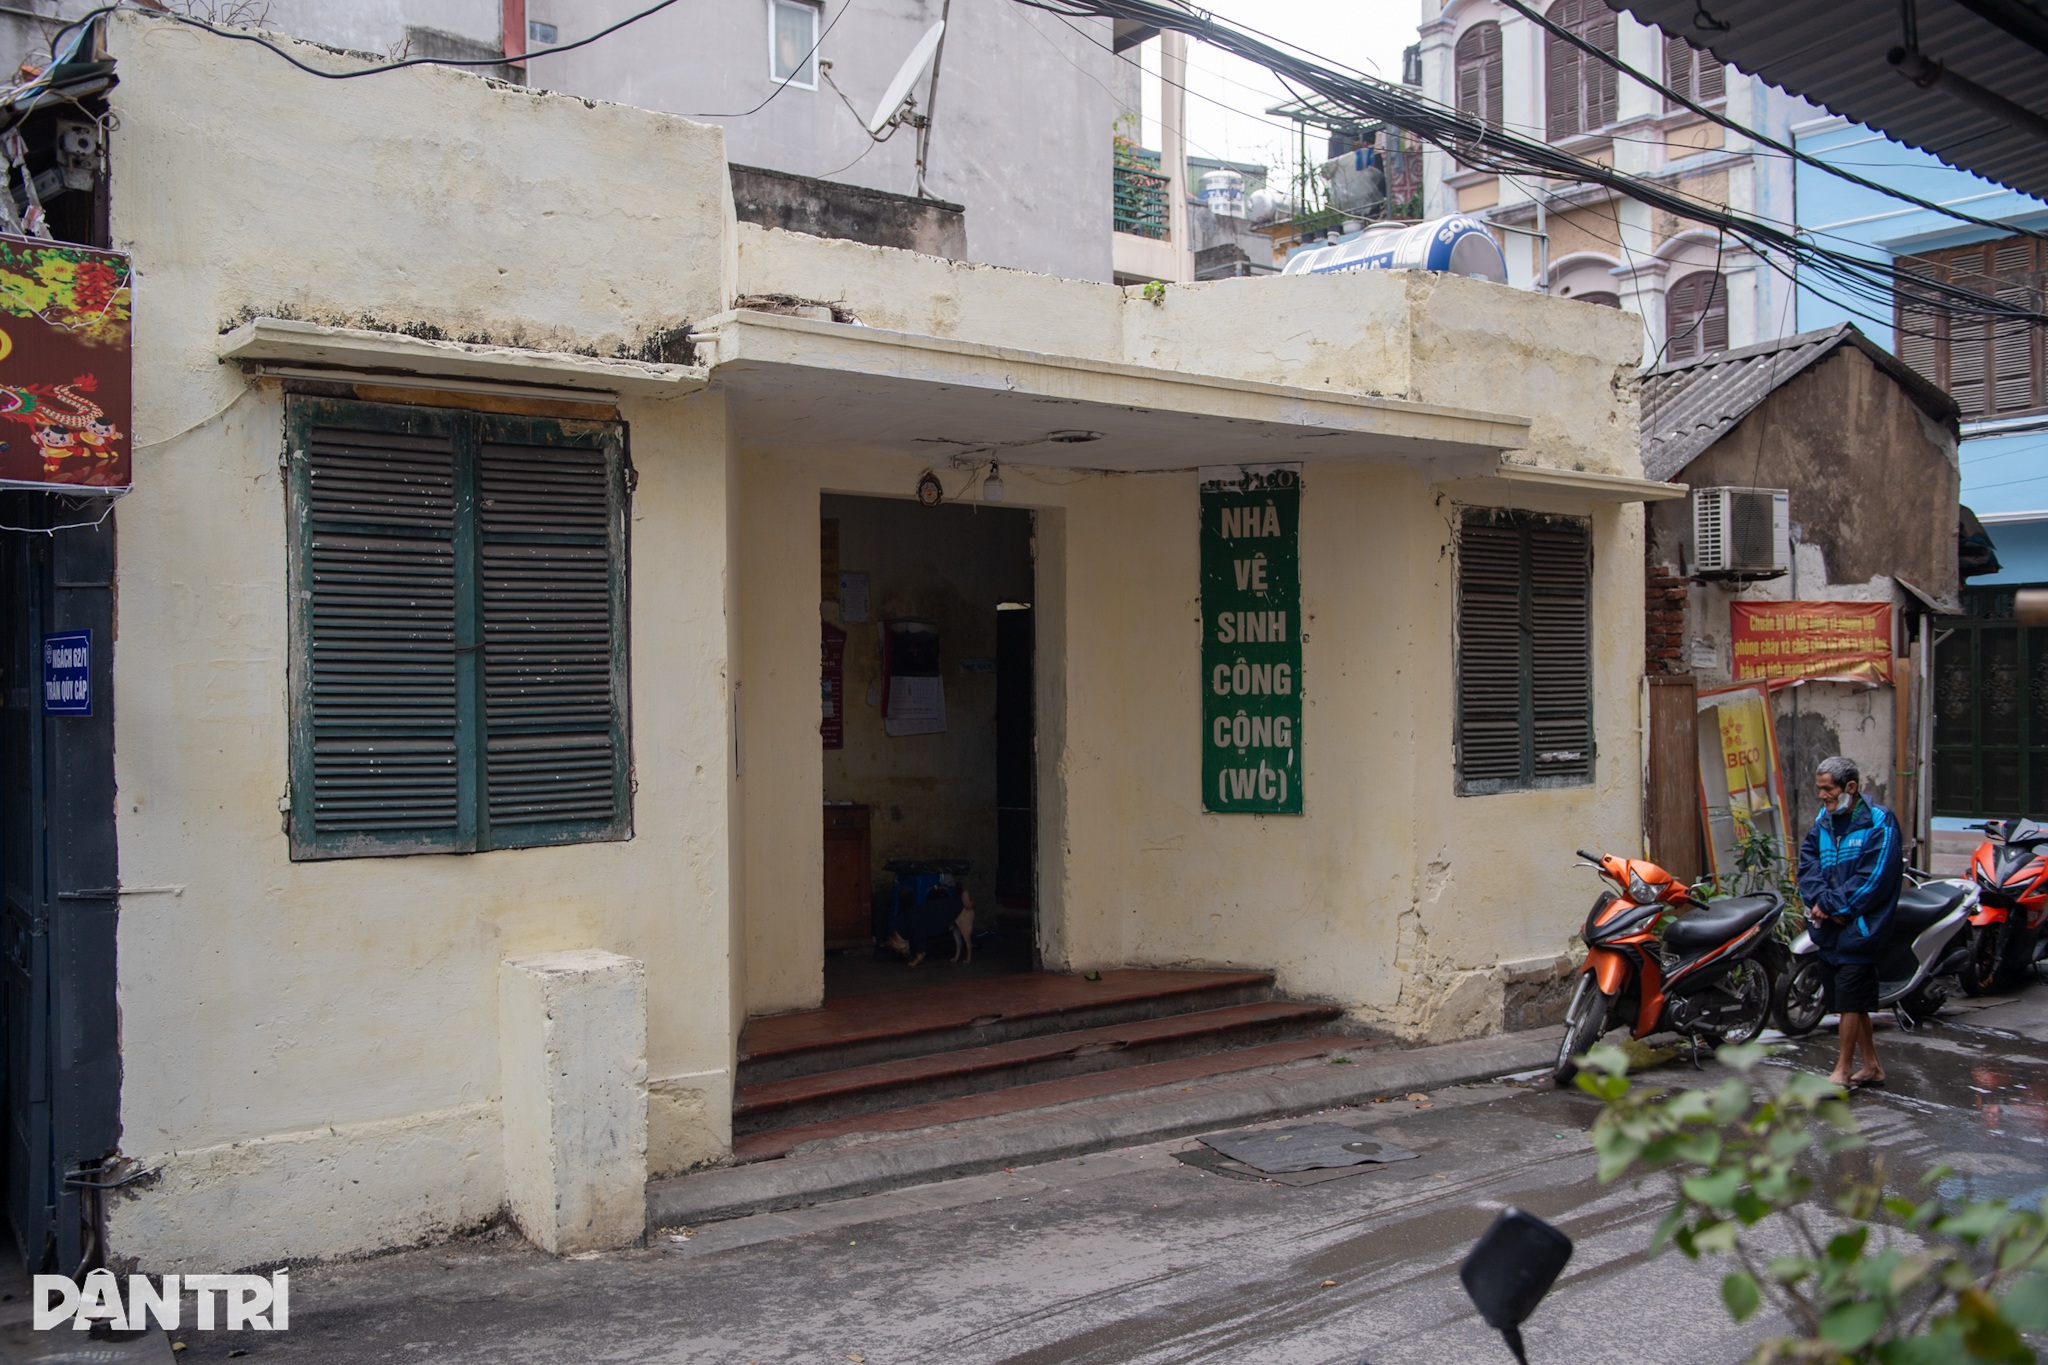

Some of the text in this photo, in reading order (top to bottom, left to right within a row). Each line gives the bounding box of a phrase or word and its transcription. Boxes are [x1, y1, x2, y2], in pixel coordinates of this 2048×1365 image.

[1221, 499, 1281, 539] NHÀ
[1233, 552, 1268, 597] VỆ
[1217, 611, 1286, 643] SINH
[52, 645, 87, 668] NGÁCH 62/1
[1734, 638, 1759, 658] phòng
[1760, 637, 1779, 656] cháy
[1781, 637, 1791, 654] và
[1213, 657, 1292, 696] CÔNG
[1213, 709, 1292, 754] CỘNG
[1725, 747, 1760, 769] BECO
[1218, 767, 1288, 804] (WC)
